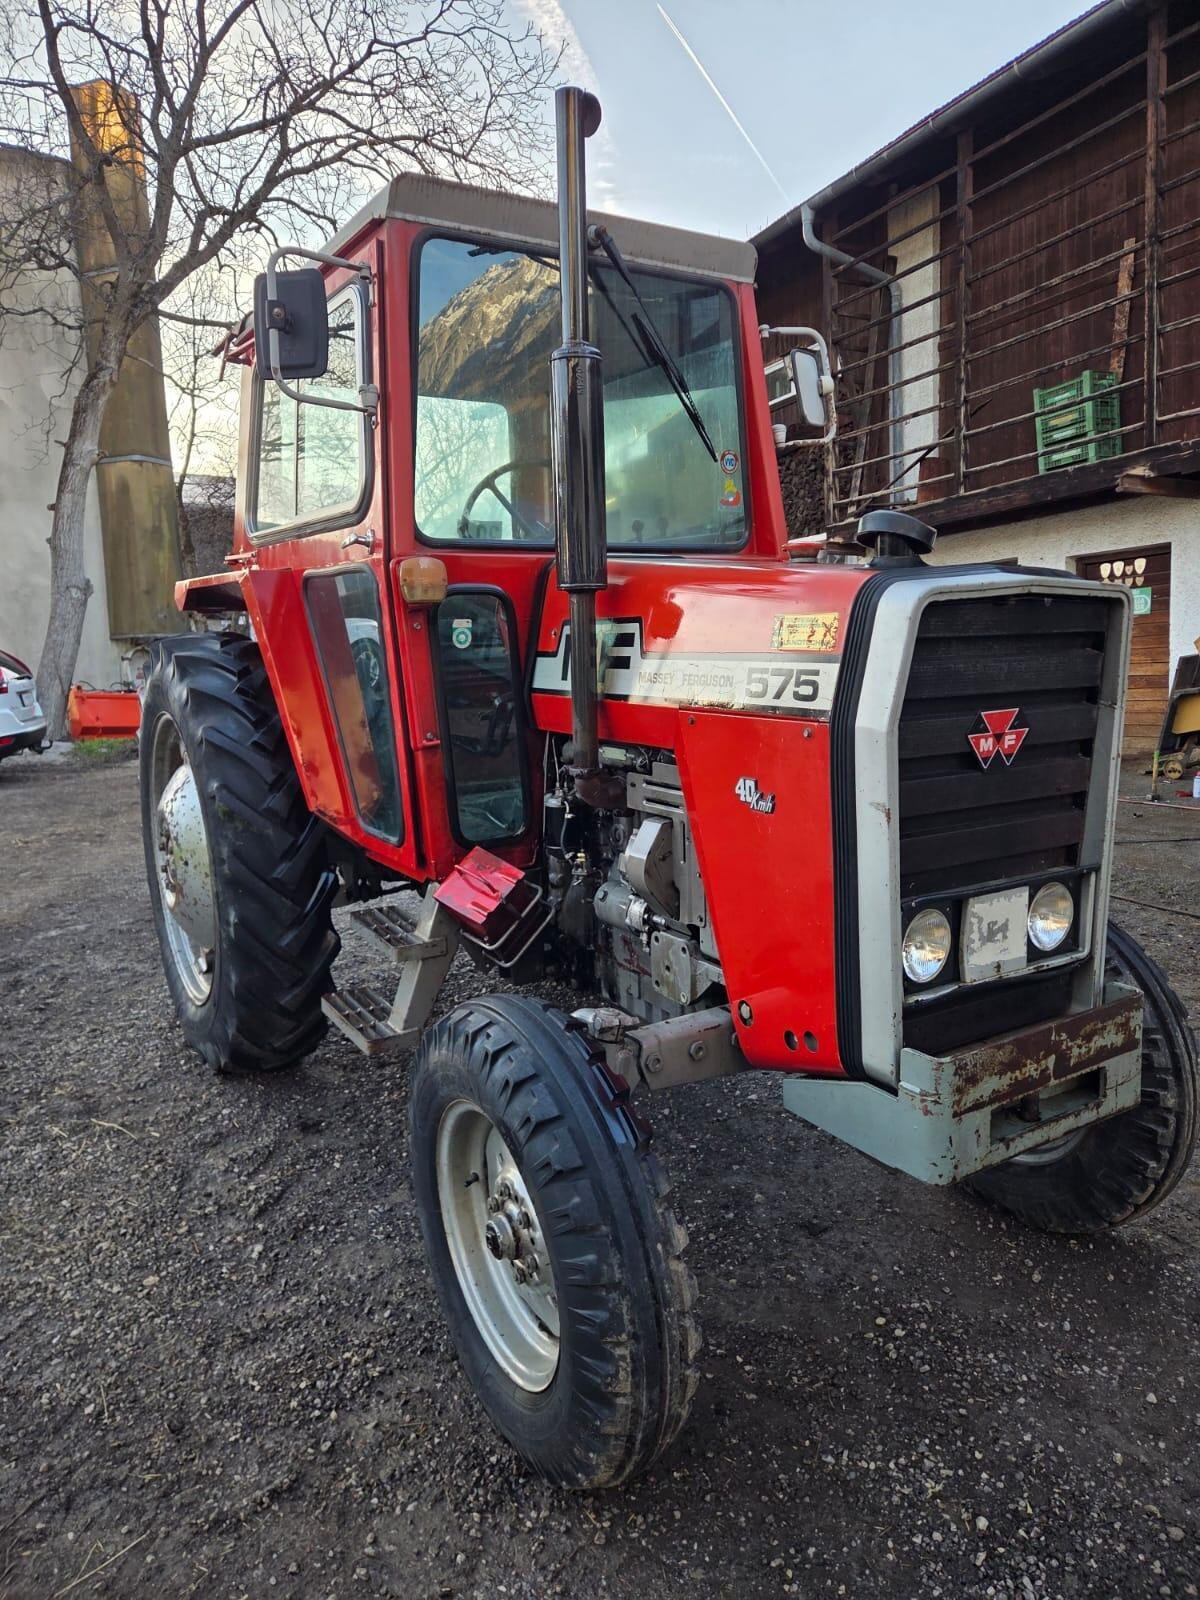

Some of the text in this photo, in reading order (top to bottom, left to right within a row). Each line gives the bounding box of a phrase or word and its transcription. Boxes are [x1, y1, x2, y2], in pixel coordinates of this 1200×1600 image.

[639, 667, 821, 702] MASSEY FERGUSON 575
[735, 777, 757, 803] 40
